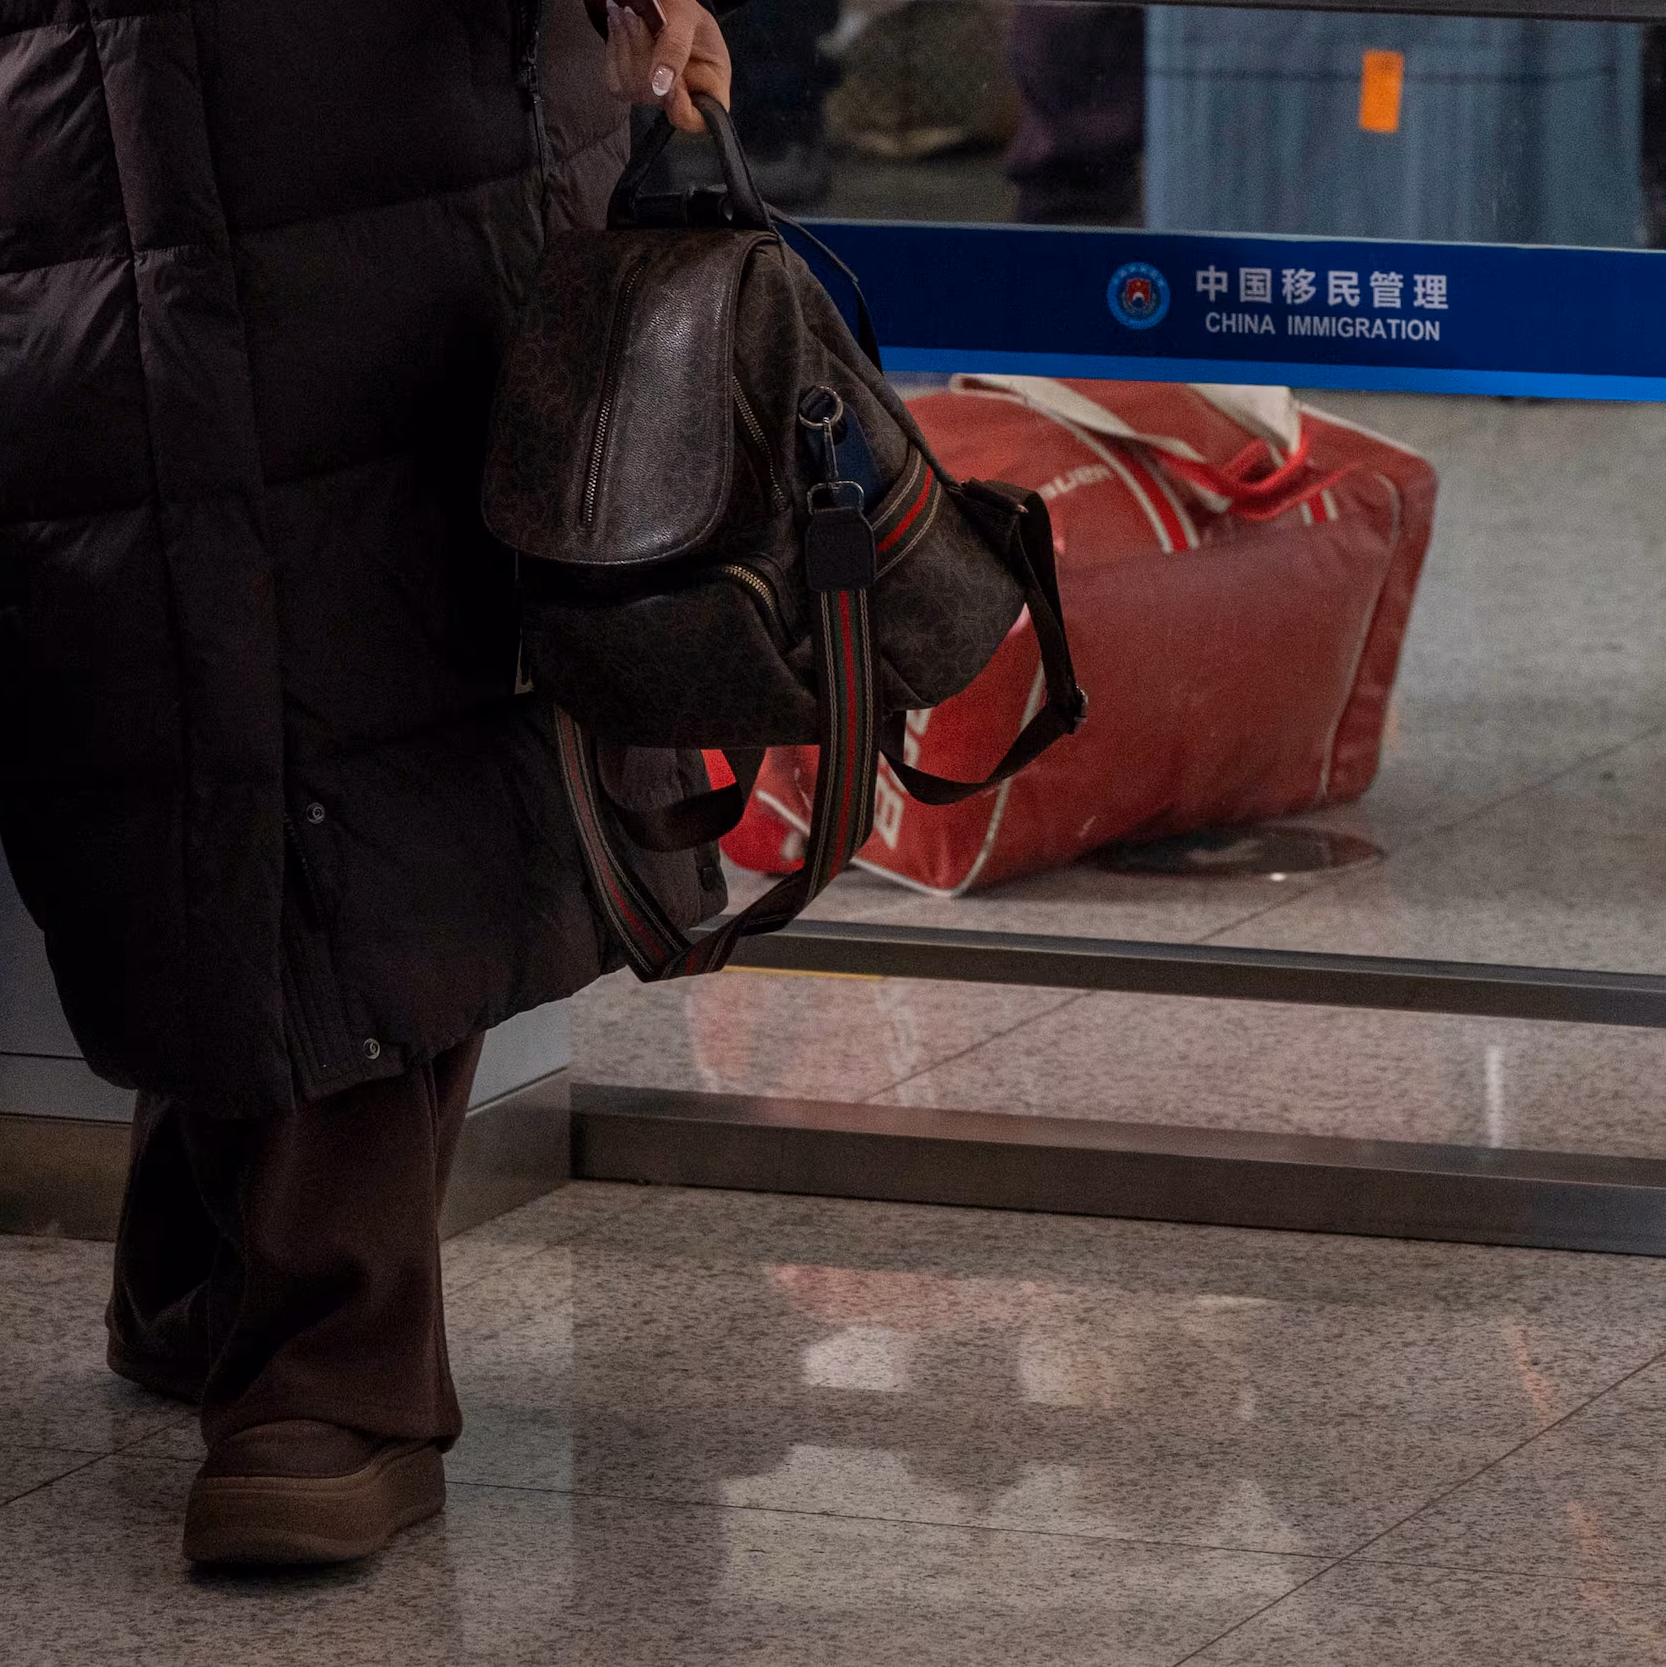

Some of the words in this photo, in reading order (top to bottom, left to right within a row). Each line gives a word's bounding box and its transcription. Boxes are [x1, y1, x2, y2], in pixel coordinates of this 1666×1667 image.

[1196, 265, 1449, 309] 中国移民管理
[1205, 312, 1276, 334] CHINA
[1288, 315, 1440, 341] IMMIGRATION
